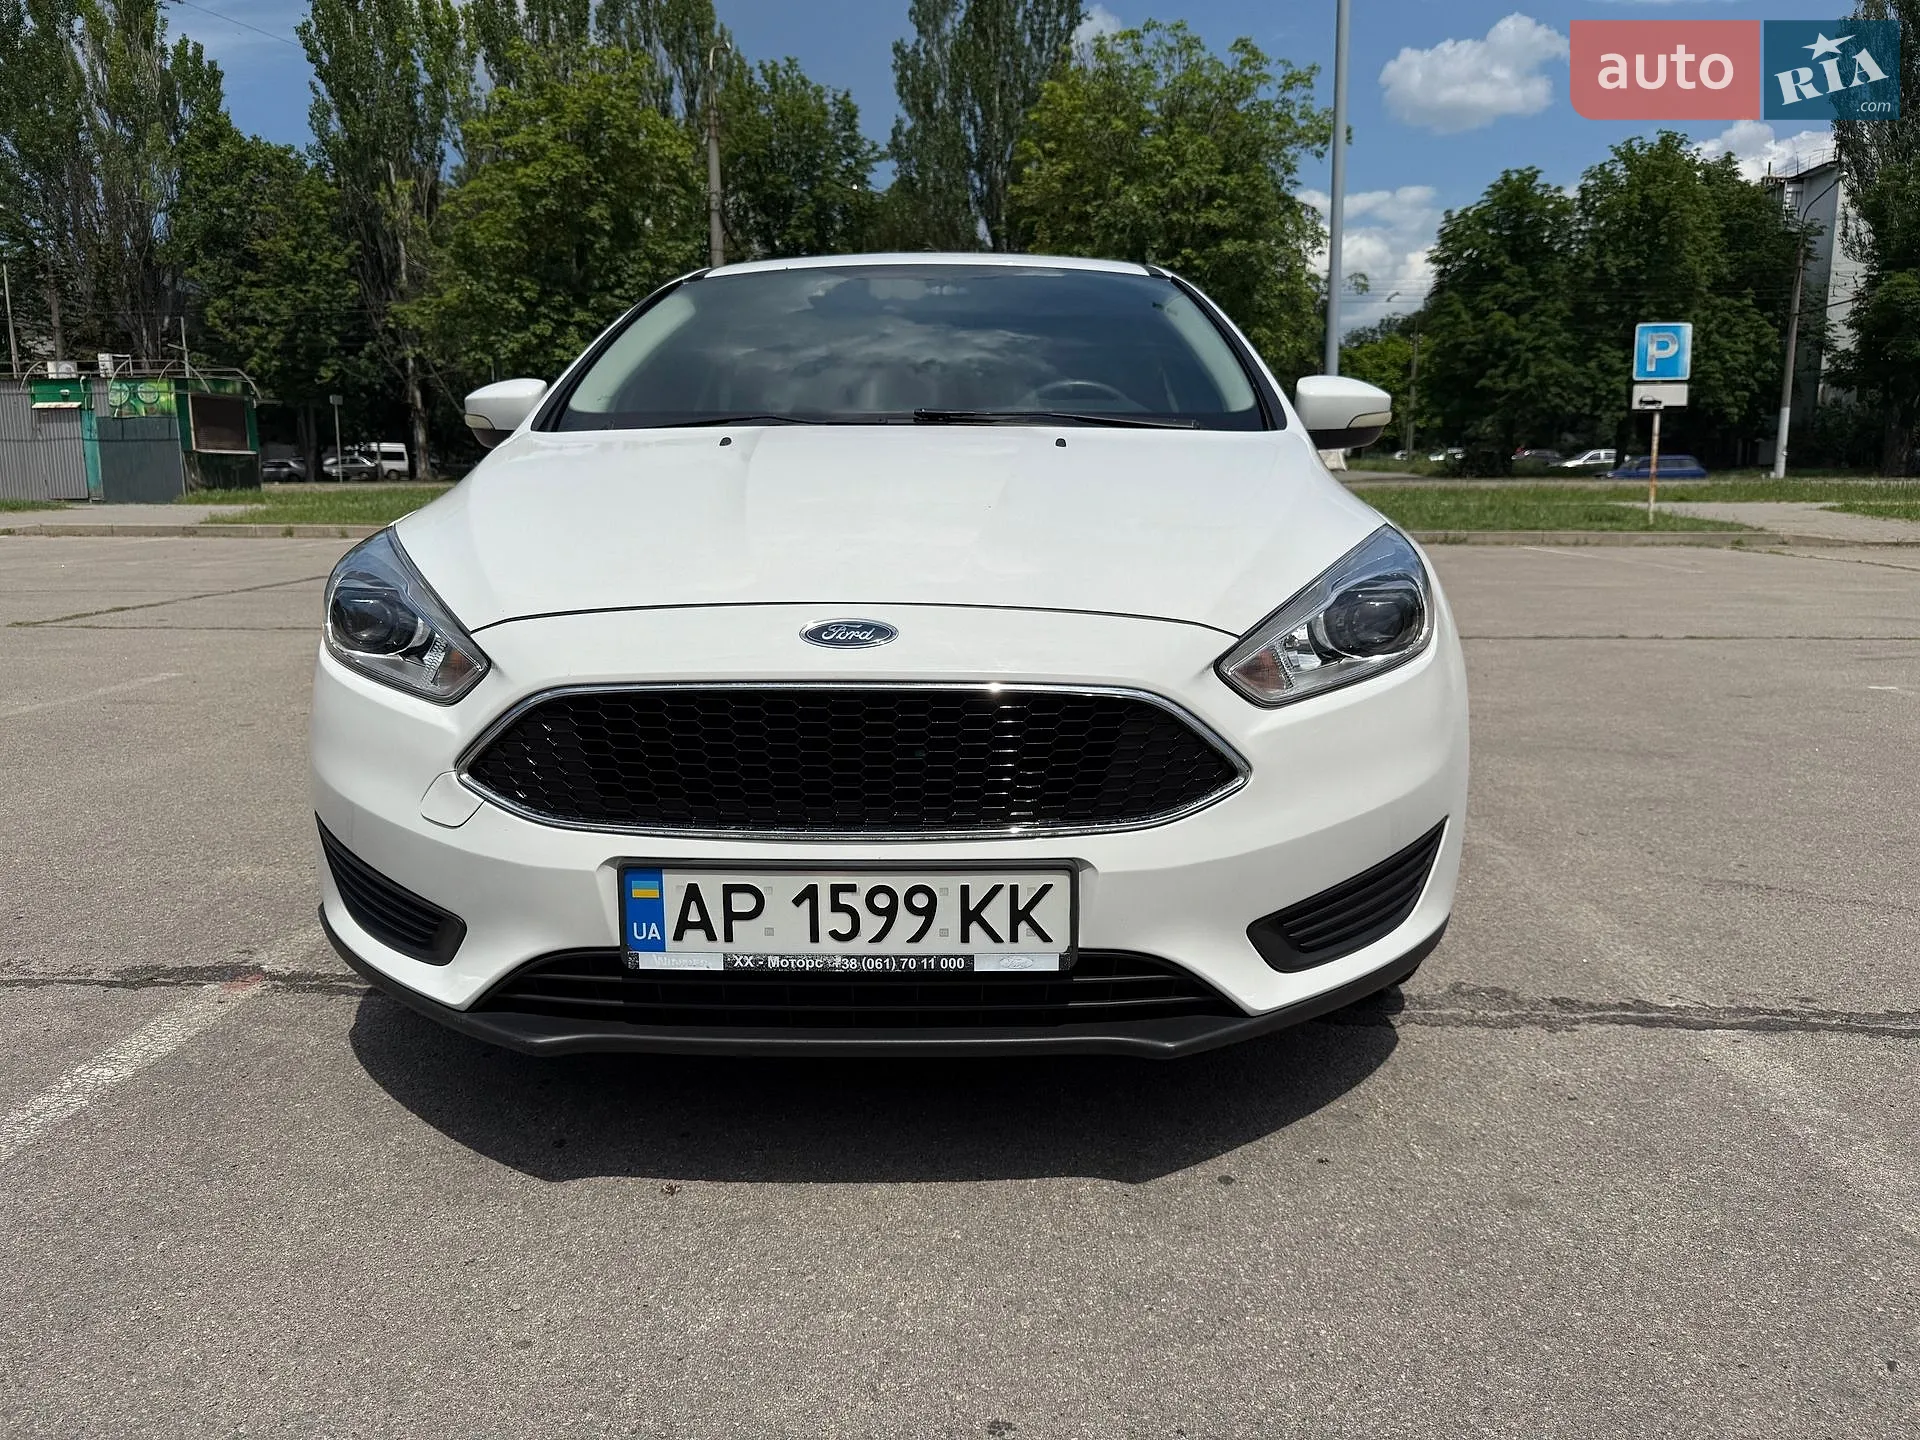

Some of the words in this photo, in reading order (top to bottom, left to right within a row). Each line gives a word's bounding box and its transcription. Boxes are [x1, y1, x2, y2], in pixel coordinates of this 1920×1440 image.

[1646, 332, 1679, 372] P
[821, 623, 876, 641] Ford
[672, 883, 766, 942] AP
[792, 884, 938, 943] 1599
[960, 884, 1054, 943] KK
[633, 922, 662, 941] UA
[767, 955, 824, 971] Моторс
[861, 956, 896, 971] (061)
[899, 958, 917, 970] 70
[920, 958, 935, 970] 11
[940, 958, 966, 970] 000
